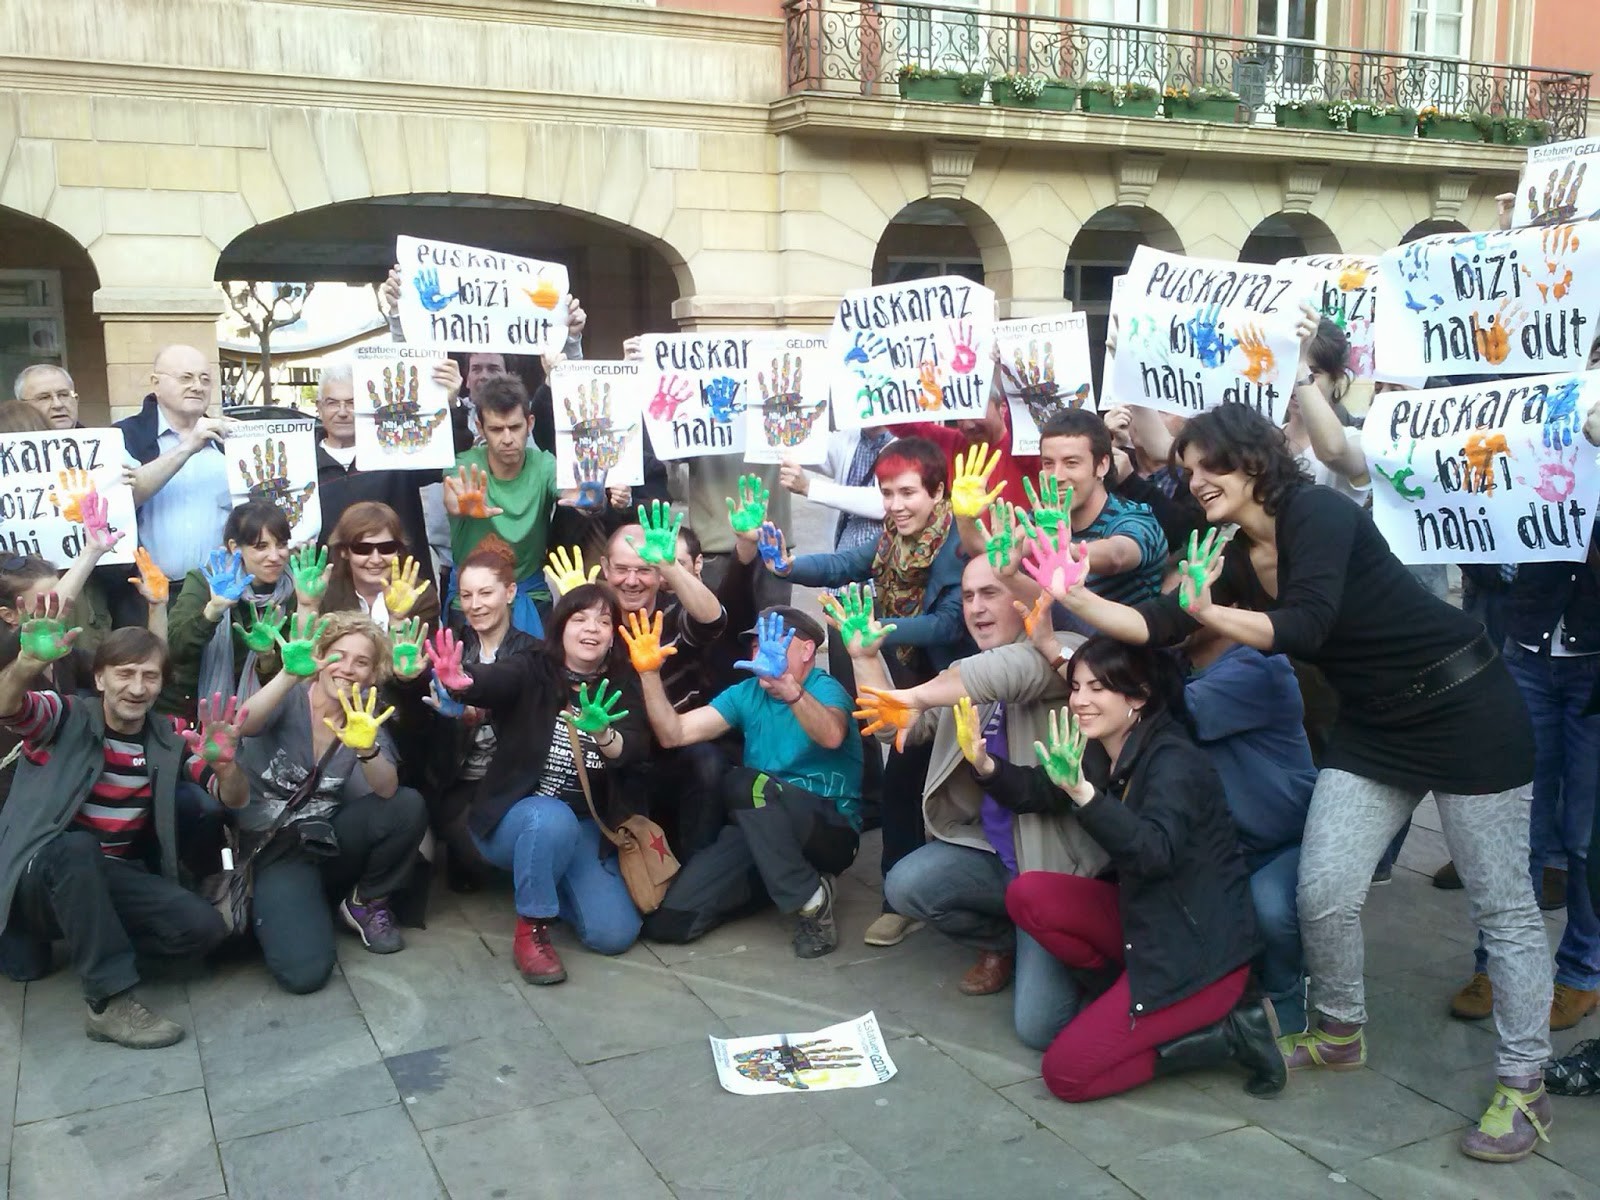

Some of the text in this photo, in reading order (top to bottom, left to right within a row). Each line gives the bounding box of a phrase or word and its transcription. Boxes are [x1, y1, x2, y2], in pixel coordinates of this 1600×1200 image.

[458, 277, 509, 308] bizi
[1146, 262, 1292, 314] euskaraz
[1451, 250, 1520, 301] bizi
[840, 285, 972, 332] euskaraz
[1322, 280, 1376, 323] bizi
[431, 314, 553, 345] nahi dut
[1030, 319, 1085, 334] GELDITU
[1521, 308, 1587, 360] dut
[358, 346, 396, 354] Estatuen
[400, 349, 445, 360] GELDITU
[886, 333, 939, 369] bizi
[593, 366, 638, 374] GELDITU
[1140, 362, 1204, 410] nahi
[941, 374, 983, 411] dut
[267, 423, 313, 434] GELDITU
[1390, 383, 1579, 442] euskaraz
[672, 417, 733, 449] nahi
[1415, 500, 1586, 552] nahi dut
